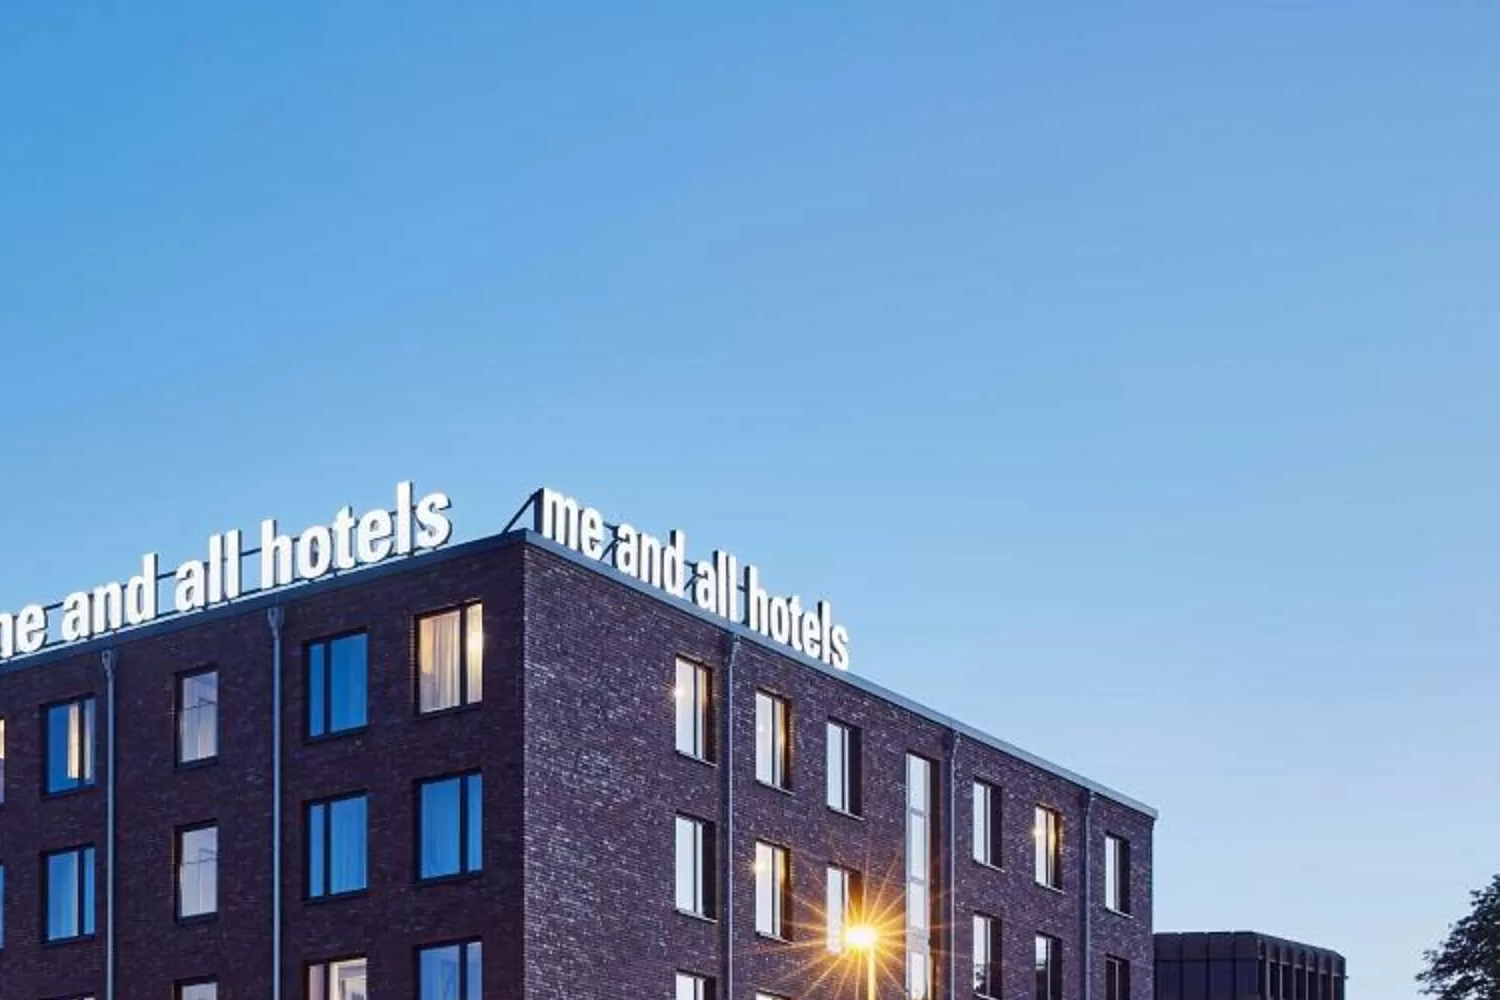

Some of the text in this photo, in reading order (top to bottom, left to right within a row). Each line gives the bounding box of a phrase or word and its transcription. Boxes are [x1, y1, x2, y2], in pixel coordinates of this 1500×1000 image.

[62, 553, 158, 641] and
[175, 528, 242, 610] all
[261, 480, 451, 591] hotels
[536, 488, 849, 671] me and all hotels
